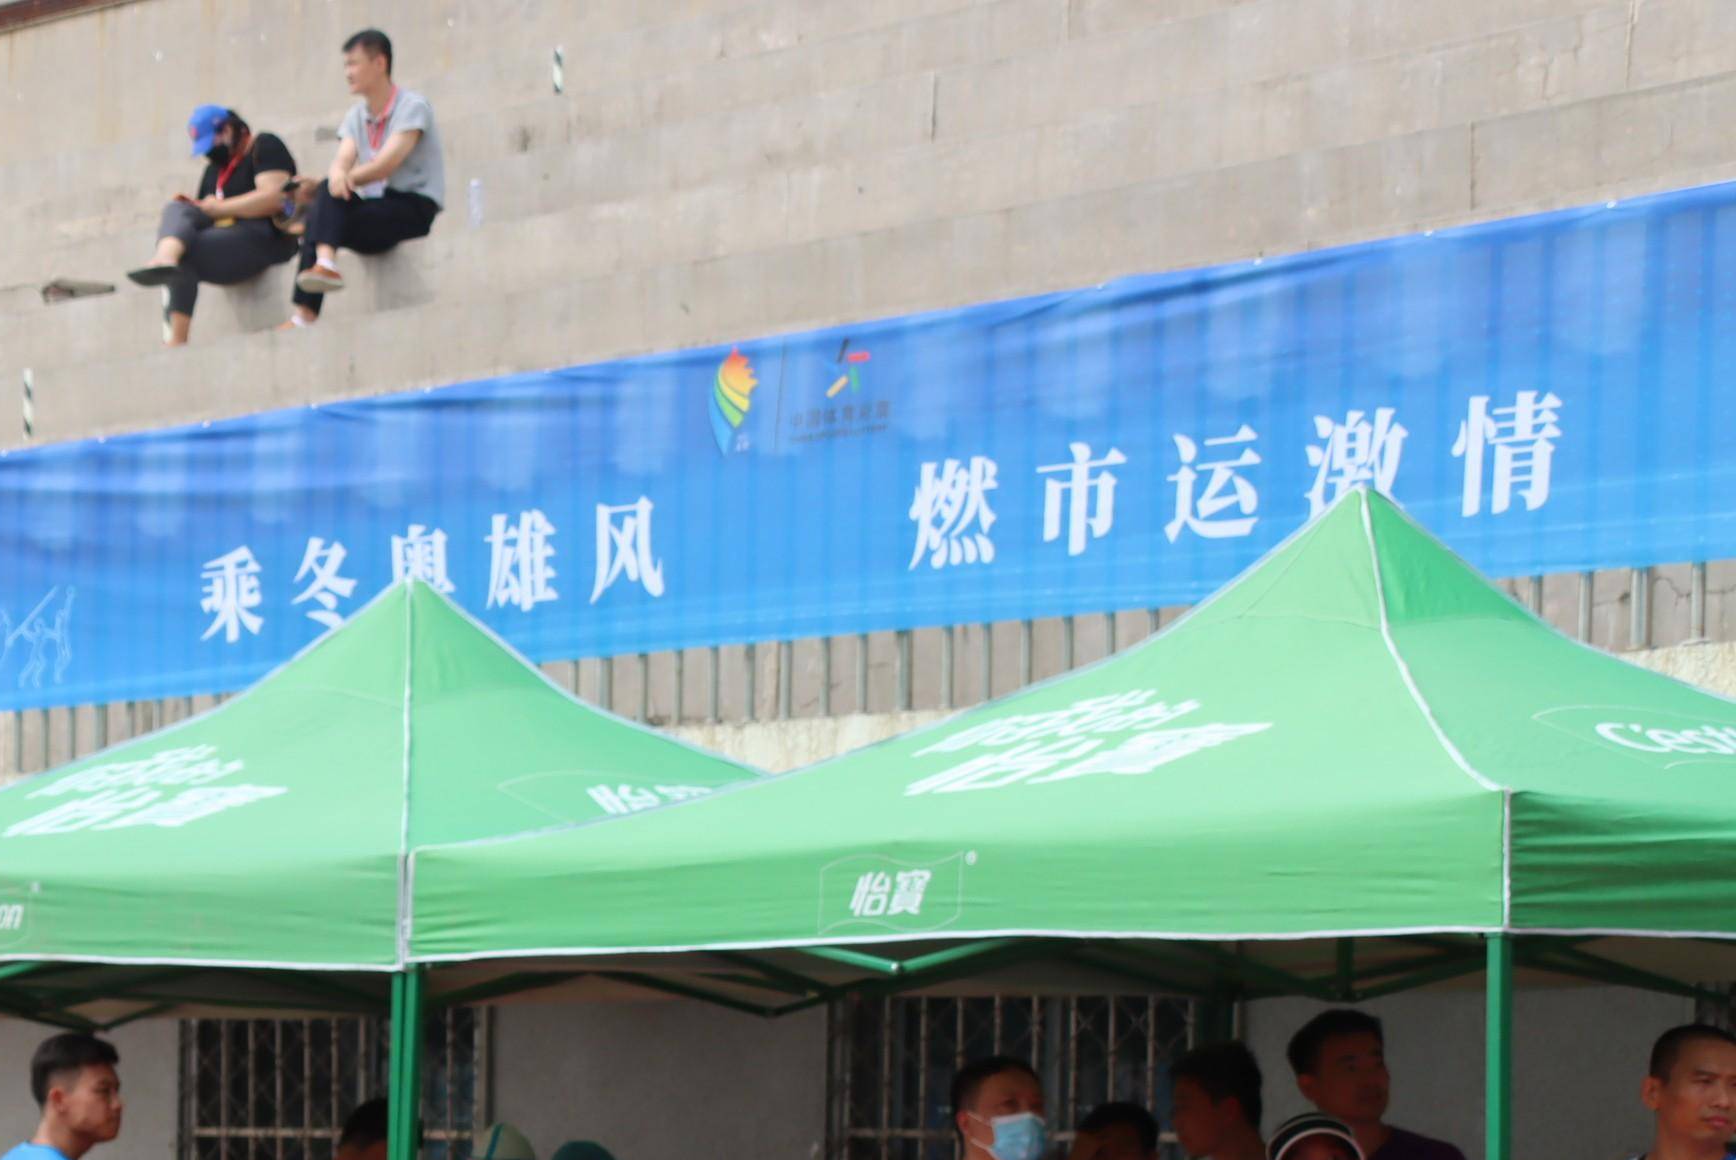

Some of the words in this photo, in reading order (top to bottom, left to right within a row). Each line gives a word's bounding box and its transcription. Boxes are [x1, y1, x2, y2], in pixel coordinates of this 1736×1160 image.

[199, 496, 665, 643] 乘冬奥雄风
[908, 390, 1563, 571] 燃市运激情
[1595, 722, 1736, 754] C'est
